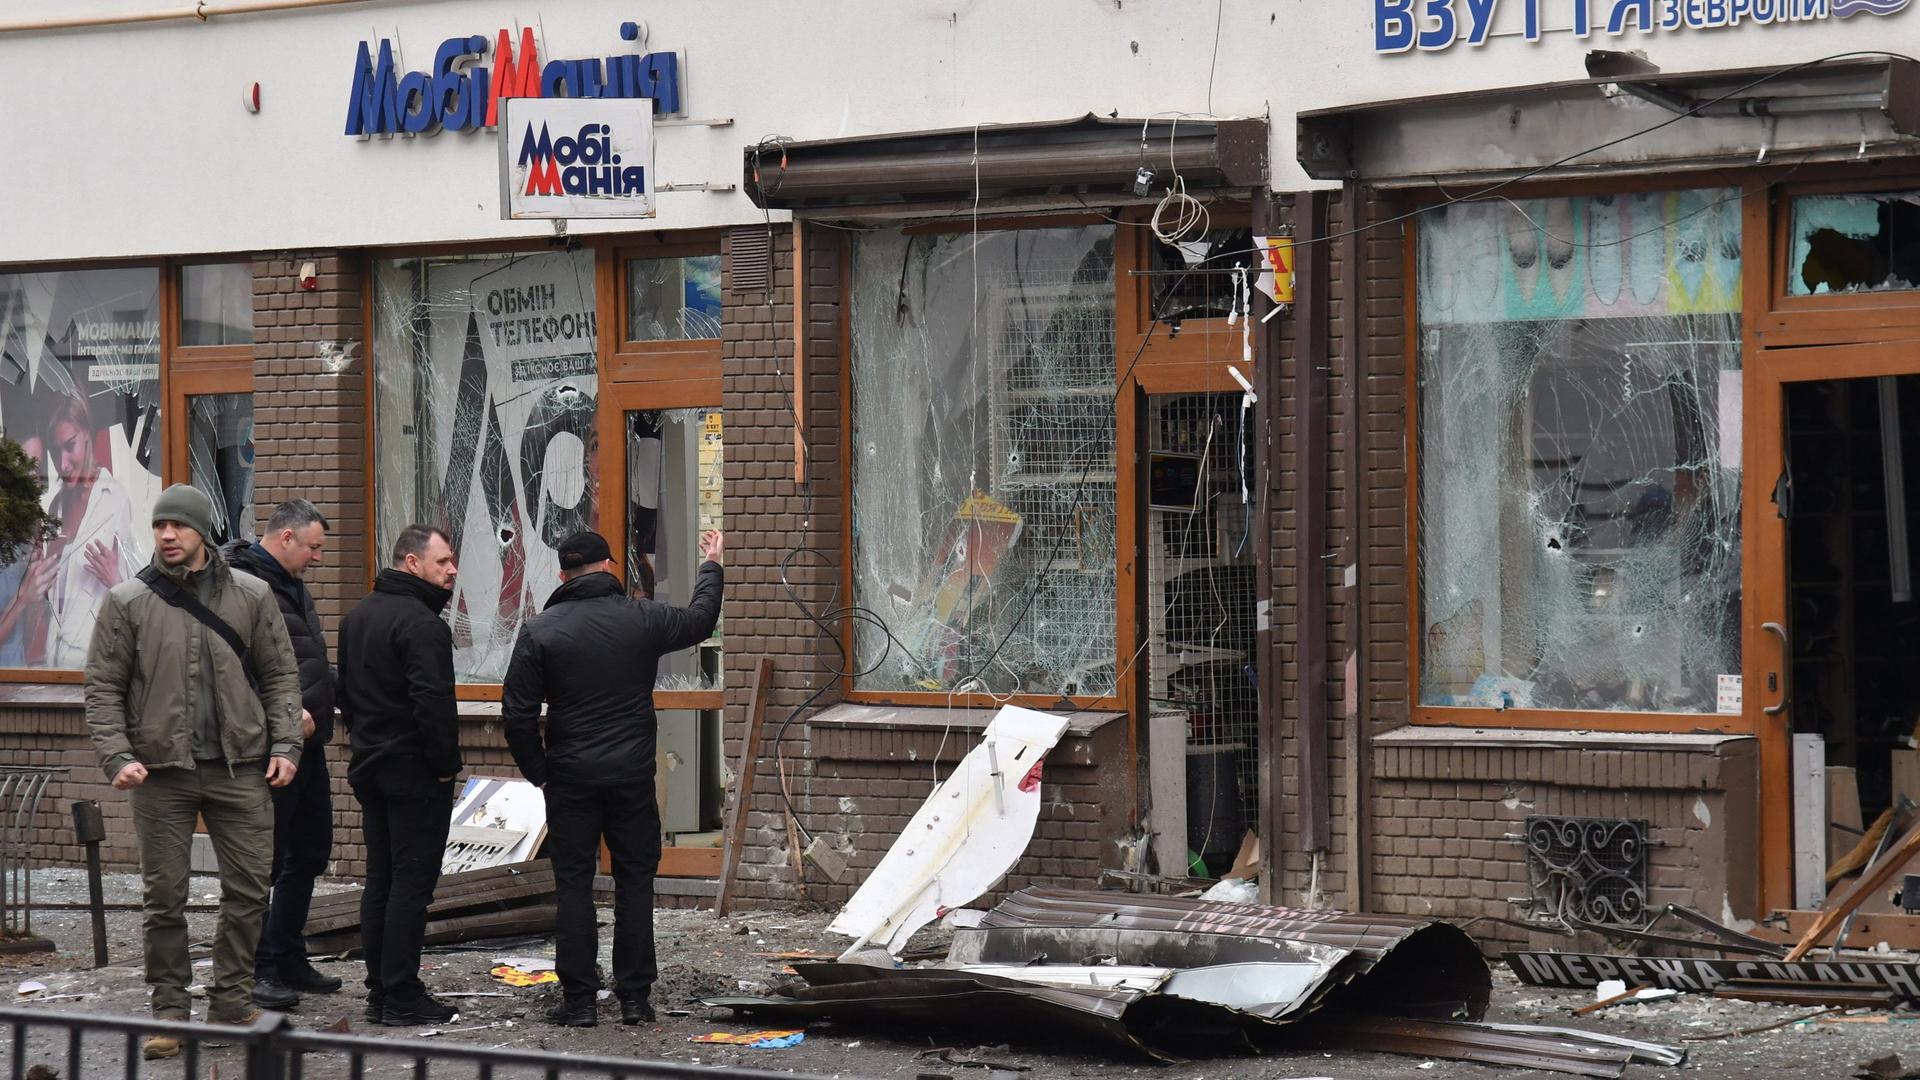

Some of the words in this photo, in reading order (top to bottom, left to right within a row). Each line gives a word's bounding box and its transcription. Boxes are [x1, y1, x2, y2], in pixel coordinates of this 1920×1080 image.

[518, 119, 612, 166] Мобі
[524, 153, 645, 196] Манія
[487, 283, 556, 315] ОБМІН
[1519, 954, 1725, 989] МЕРЕЖА
[1736, 961, 1920, 996] СМАЧН
